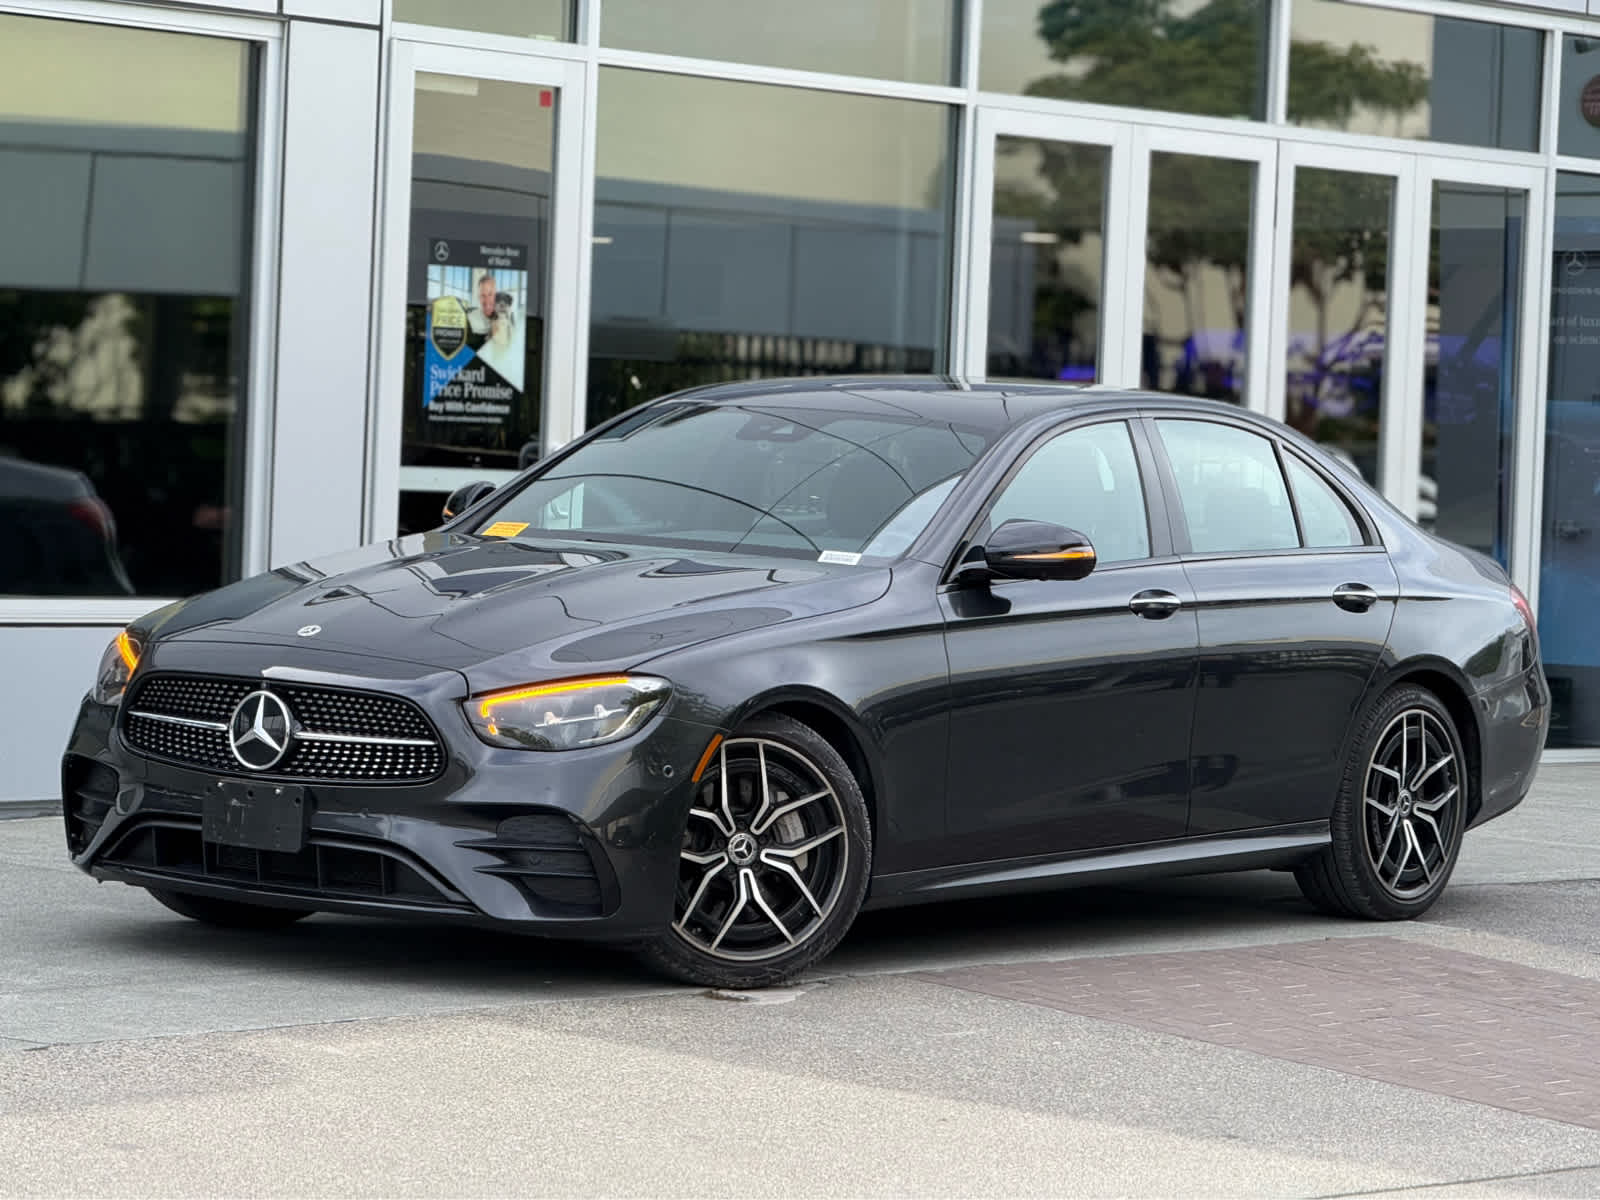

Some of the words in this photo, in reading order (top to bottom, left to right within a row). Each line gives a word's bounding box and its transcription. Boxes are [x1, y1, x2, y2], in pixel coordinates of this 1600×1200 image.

[430, 365, 486, 383] Swickard
[430, 381, 462, 398] Price
[464, 382, 513, 400] Promise
